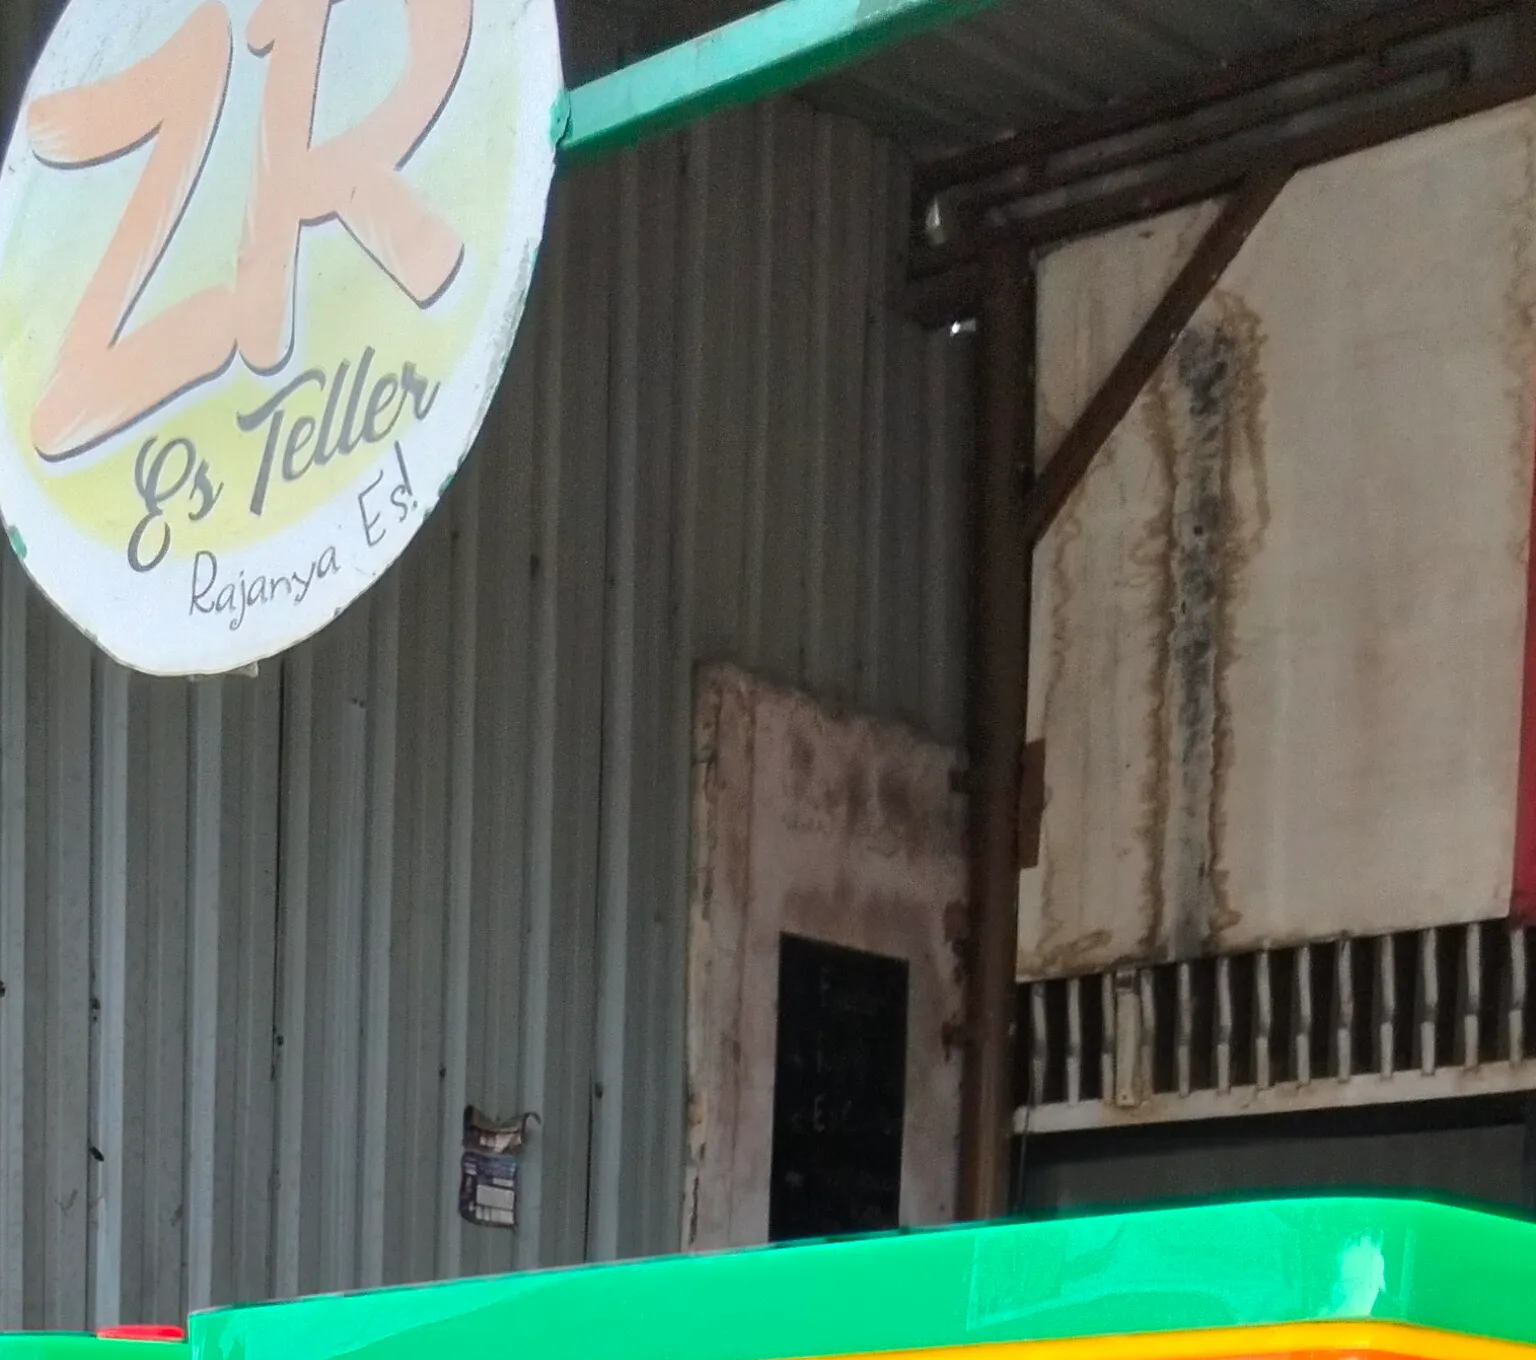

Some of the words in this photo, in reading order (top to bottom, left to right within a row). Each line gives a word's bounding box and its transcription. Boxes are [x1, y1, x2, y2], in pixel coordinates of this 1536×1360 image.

[27, 0, 473, 462] ZR
[126, 435, 224, 573] Es
[236, 345, 441, 516] Teller
[187, 549, 340, 631] Rajanya
[357, 441, 419, 549] Es!
